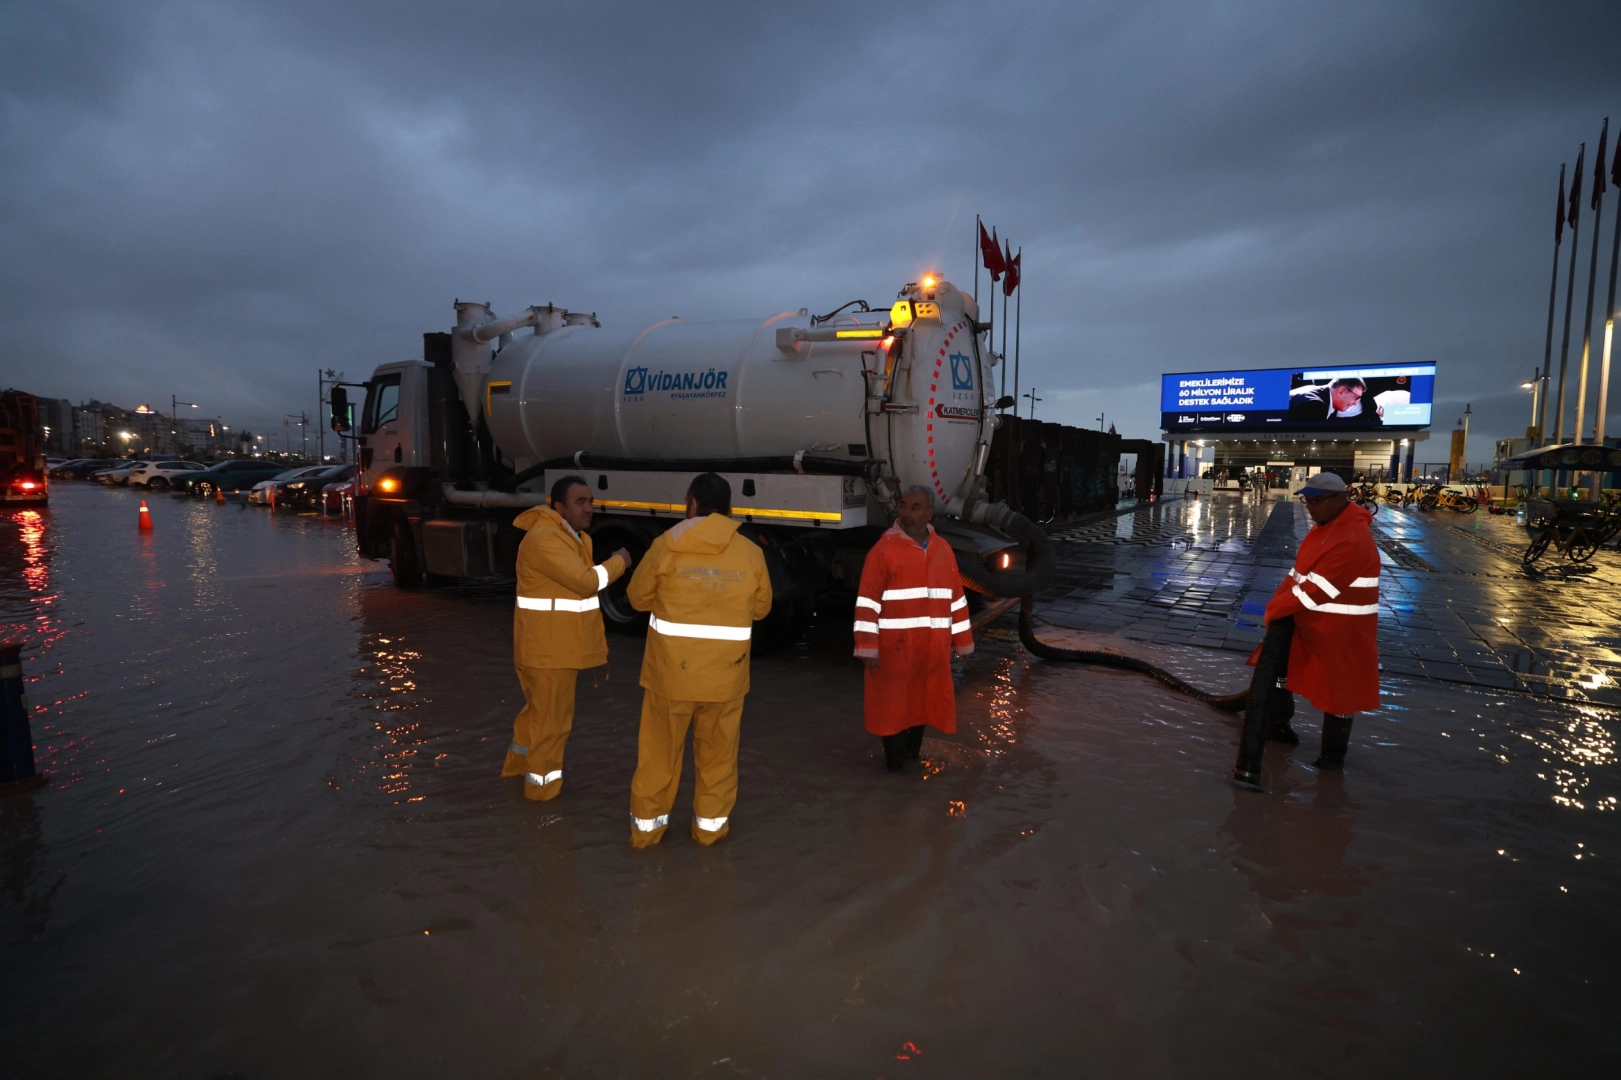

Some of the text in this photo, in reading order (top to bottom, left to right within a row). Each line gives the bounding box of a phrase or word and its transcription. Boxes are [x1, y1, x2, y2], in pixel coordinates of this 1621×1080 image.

[648, 368, 728, 391] VİDANJÖR
[1179, 377, 1245, 388] EMEKLİLERİMİZE
[1178, 386, 1255, 397] 60 MİLYON LİRALIK
[1178, 396, 1254, 406] DESTEK SAĞLADIK
